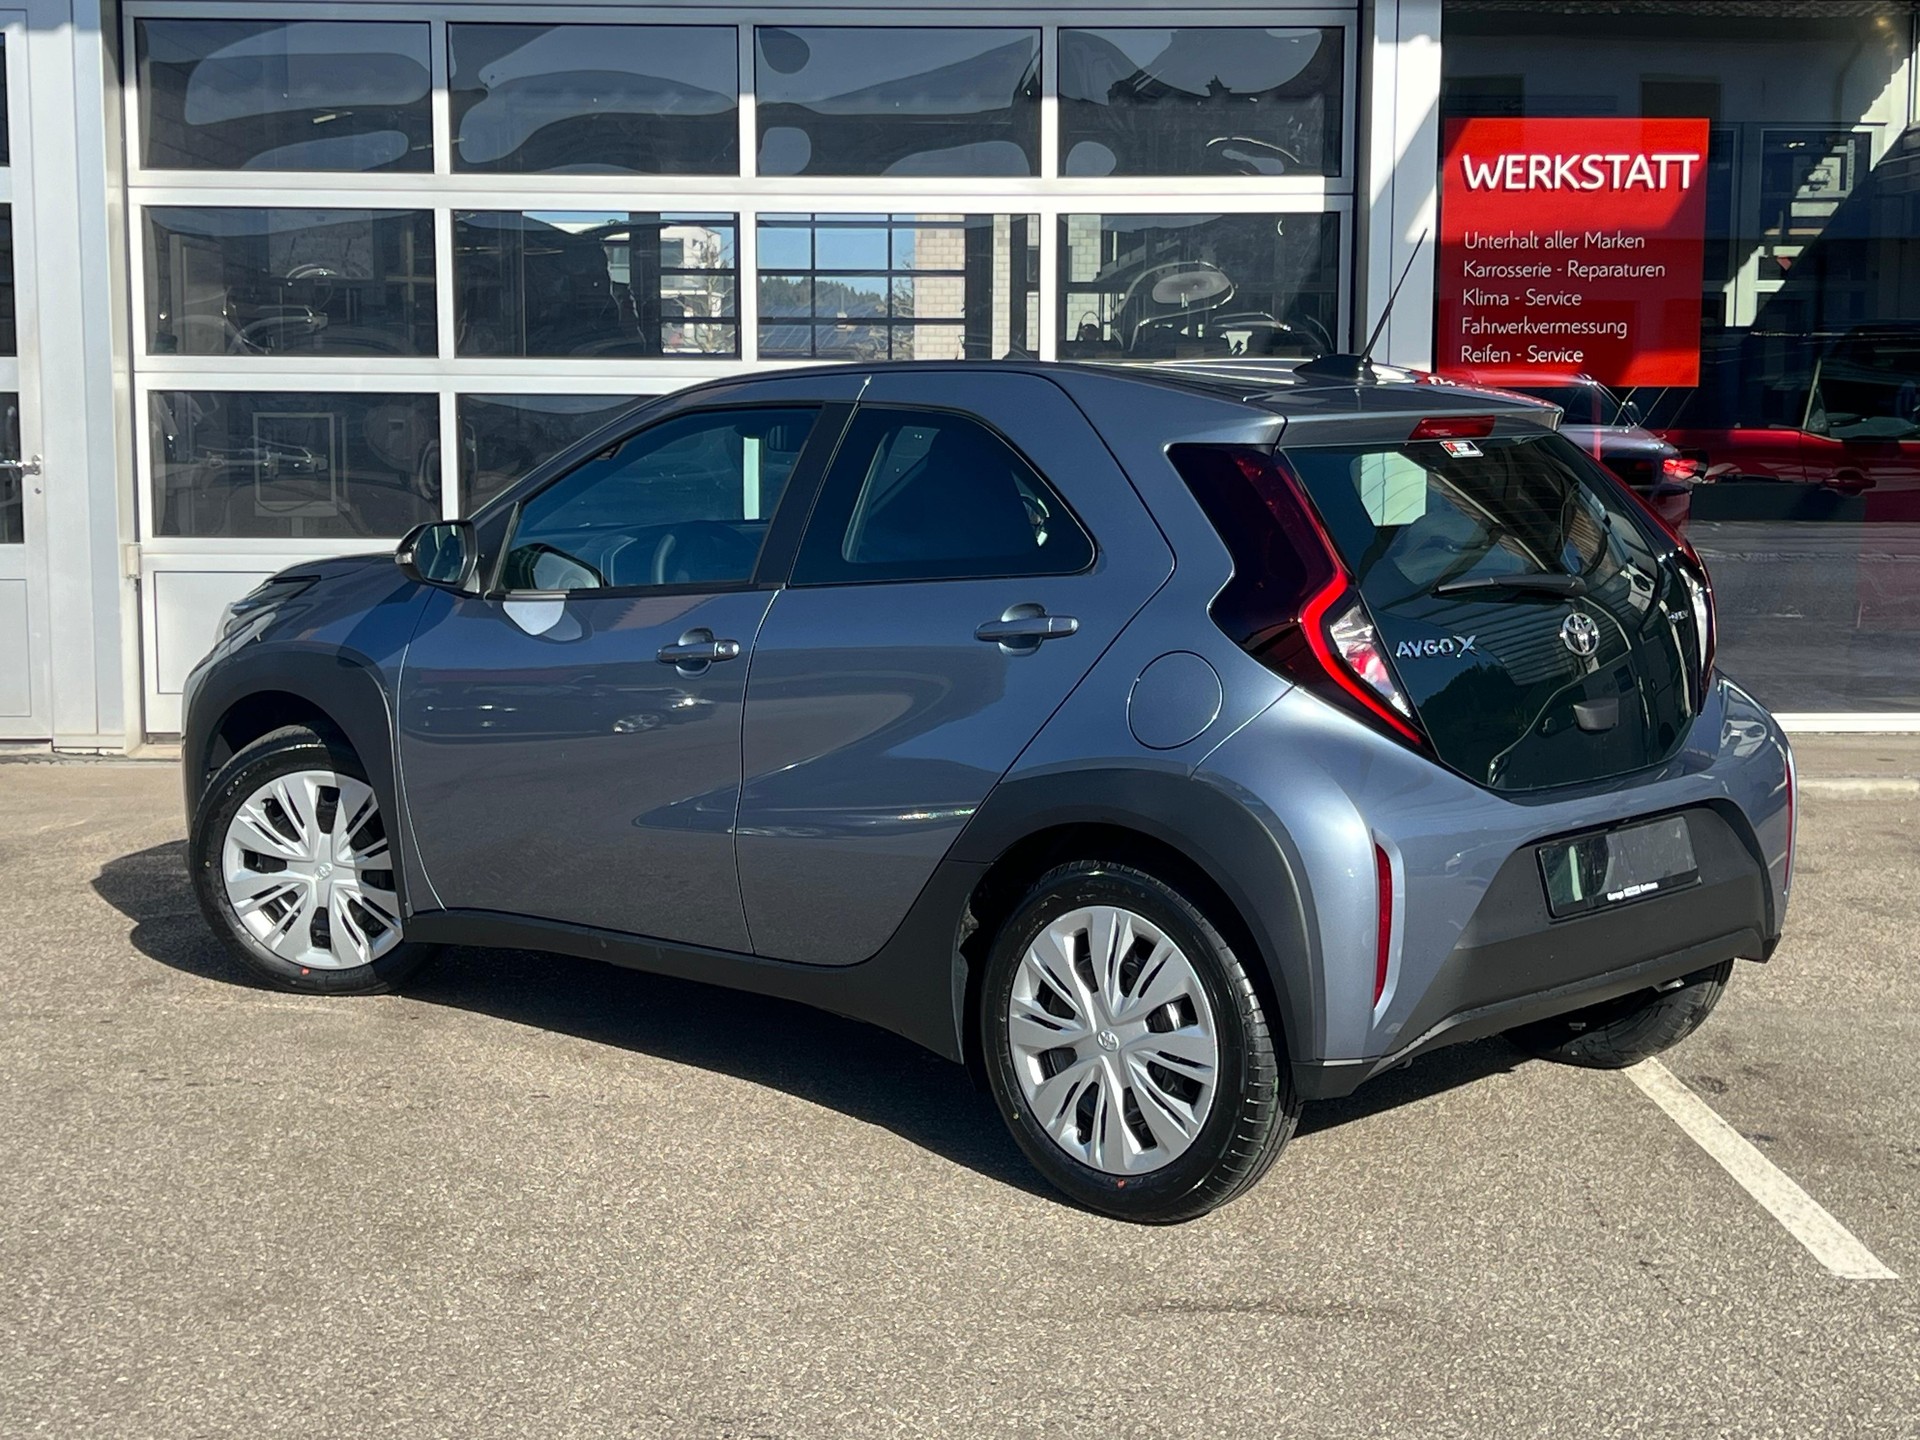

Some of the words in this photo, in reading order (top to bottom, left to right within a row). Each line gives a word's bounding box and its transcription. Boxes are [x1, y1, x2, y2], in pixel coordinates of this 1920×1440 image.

[1462, 153, 1700, 190] WERKSTATT
[1464, 231, 1539, 250] Unterhalt
[1543, 231, 1579, 250] aller
[1584, 231, 1645, 249] Marken
[1463, 260, 1552, 278] Karrosserie
[1567, 260, 1666, 282] Reparaturen
[1462, 288, 1509, 306] Klima
[1525, 289, 1582, 306] Service
[1461, 316, 1628, 339] Fahrwerkvermessung
[1461, 344, 1511, 363] Reifen
[1527, 345, 1584, 363] Service
